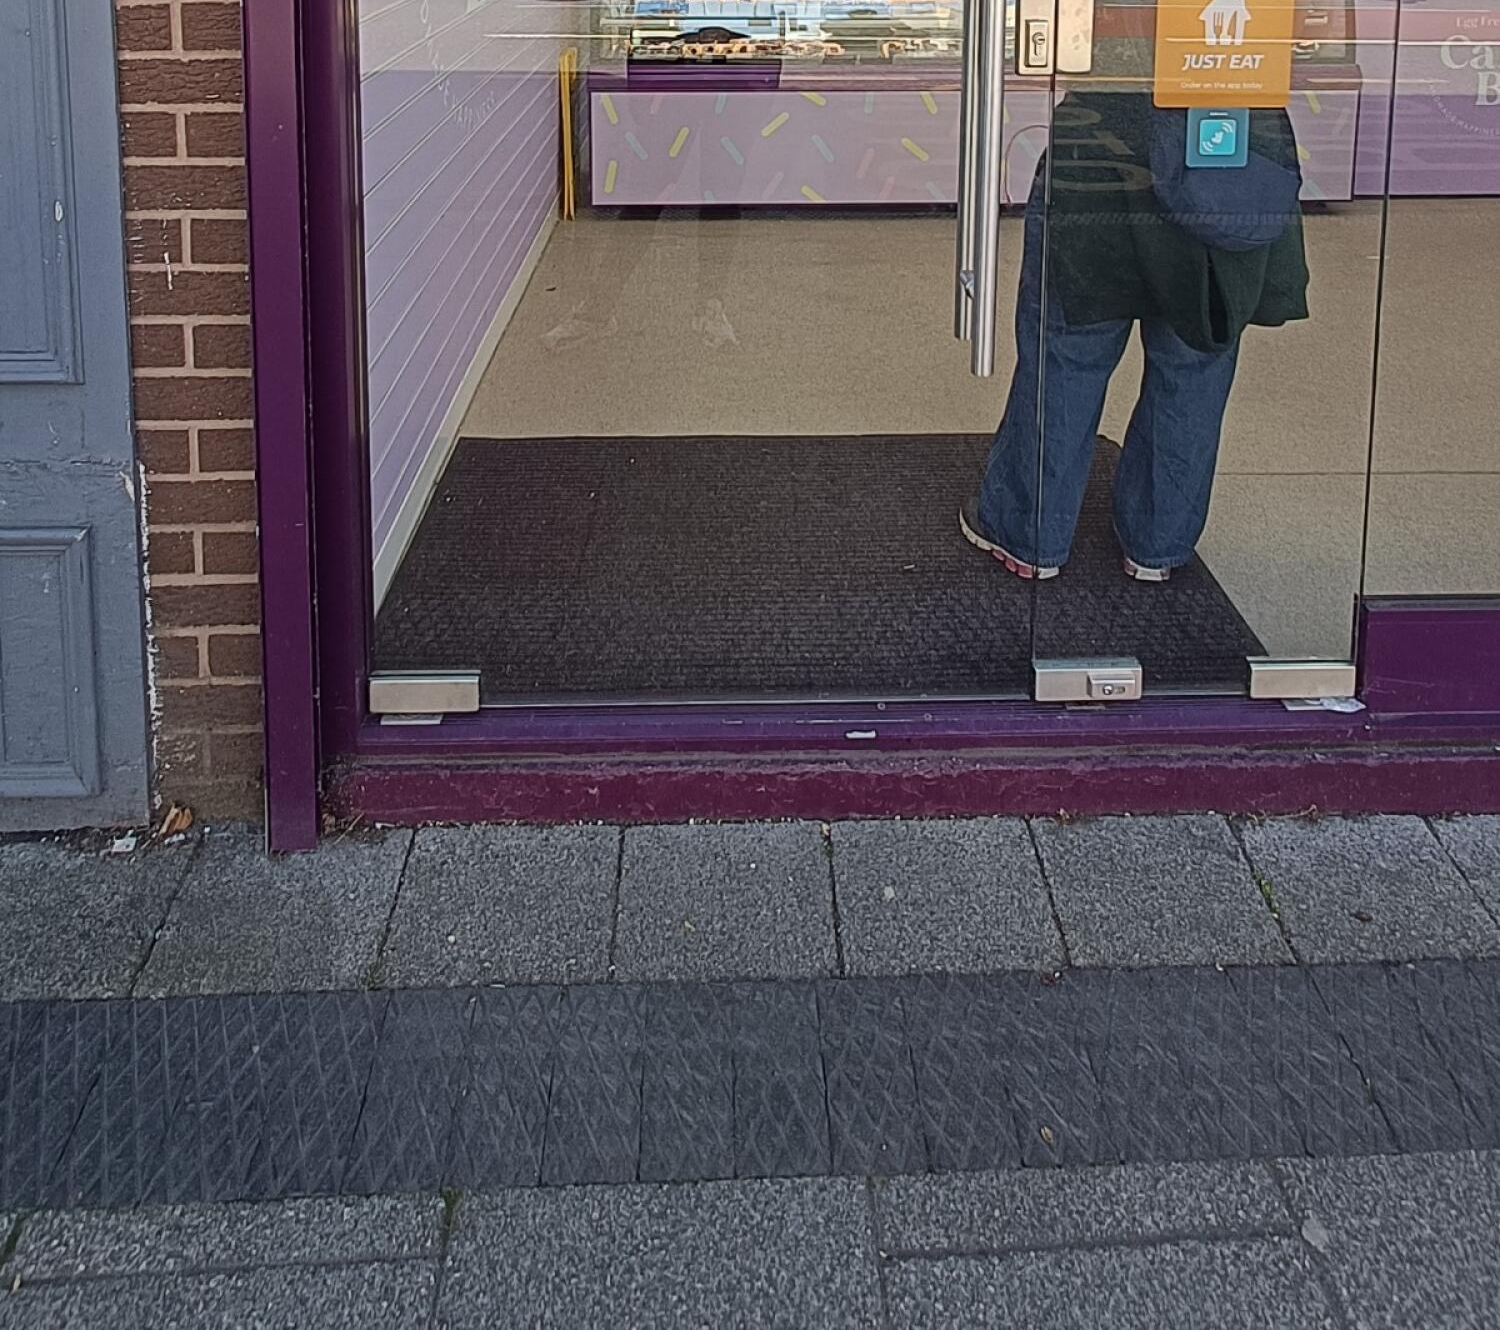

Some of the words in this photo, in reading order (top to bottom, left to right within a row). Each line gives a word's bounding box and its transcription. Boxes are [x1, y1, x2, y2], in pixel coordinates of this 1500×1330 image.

[1181, 54, 1227, 71] JUST
[1229, 54, 1265, 70] EAT
[1214, 82, 1226, 90] the
